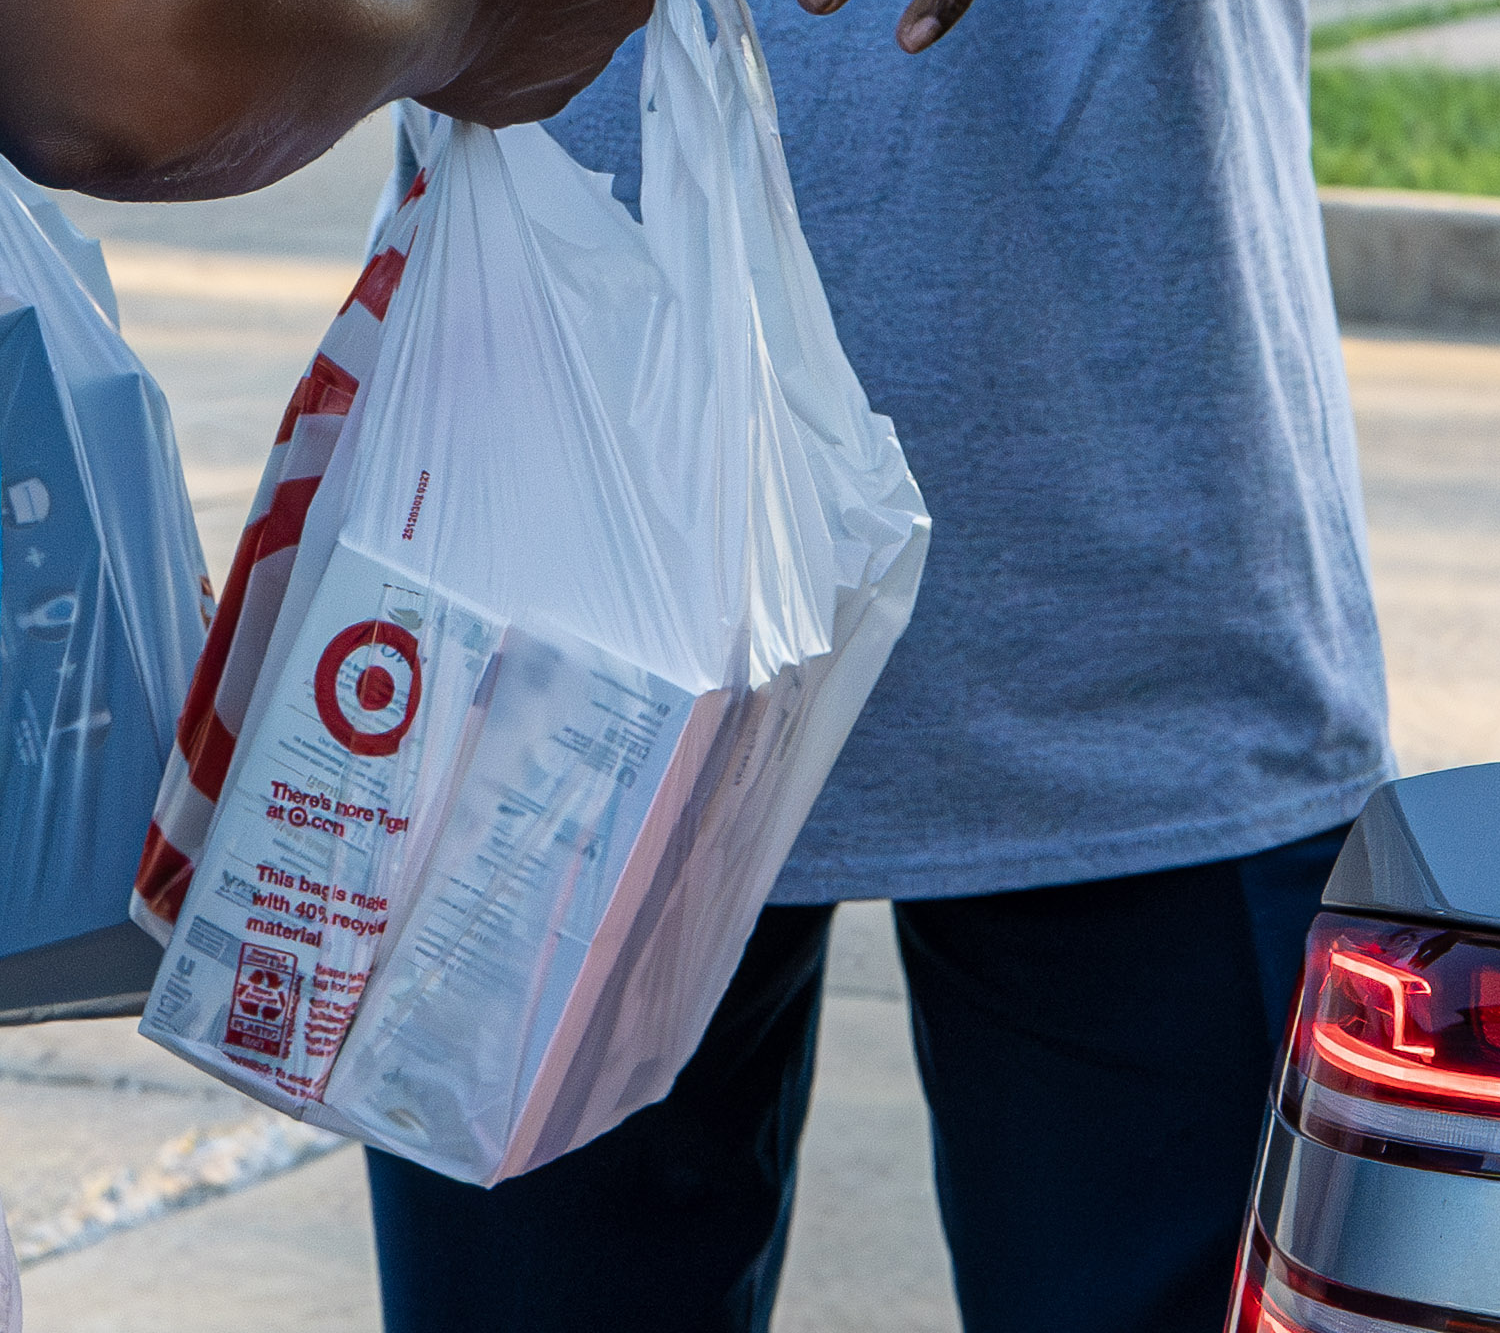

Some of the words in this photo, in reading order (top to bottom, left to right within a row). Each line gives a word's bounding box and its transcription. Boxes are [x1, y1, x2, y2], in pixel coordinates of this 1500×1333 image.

[271, 780, 331, 811] There's
[266, 805, 284, 820] at
[256, 864, 294, 889] This
[298, 875, 329, 902] bag
[332, 884, 346, 902] is
[252, 891, 290, 914] with
[294, 901, 328, 924] 40%
[246, 917, 323, 948] material
